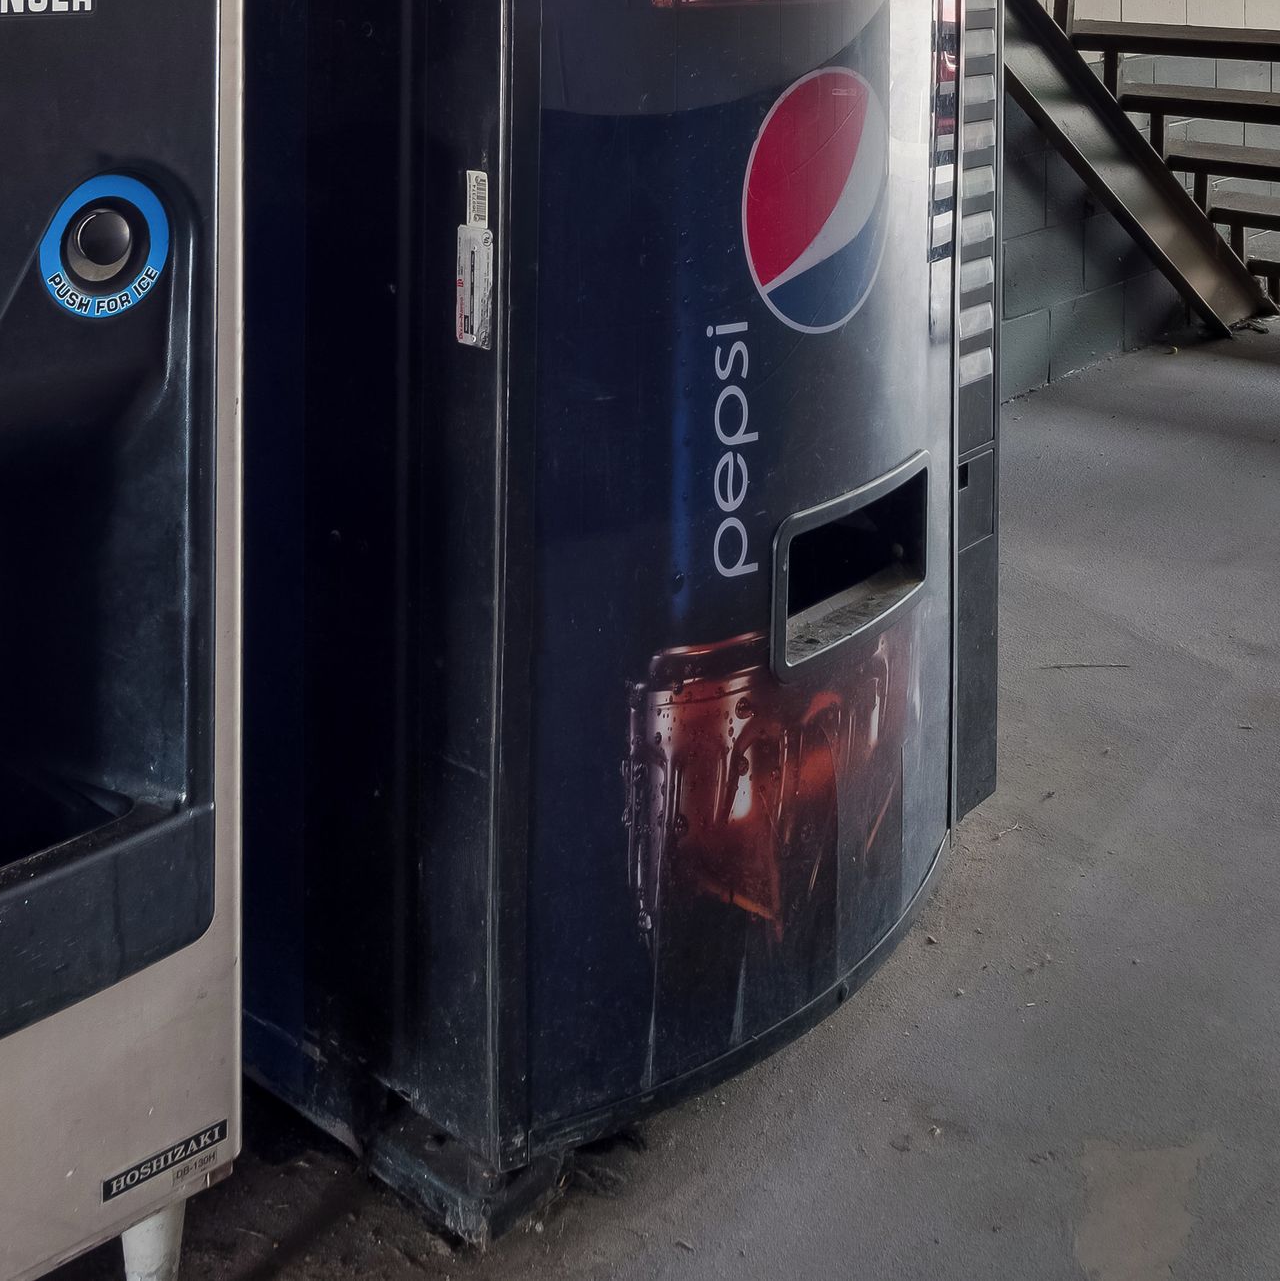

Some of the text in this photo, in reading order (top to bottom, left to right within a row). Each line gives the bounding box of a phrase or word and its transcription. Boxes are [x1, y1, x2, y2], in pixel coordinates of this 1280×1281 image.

[47, 265, 160, 316] PUSH FOR ICE
[706, 321, 759, 578] pepsi
[110, 1125, 221, 1196] HOSHIZAKI
